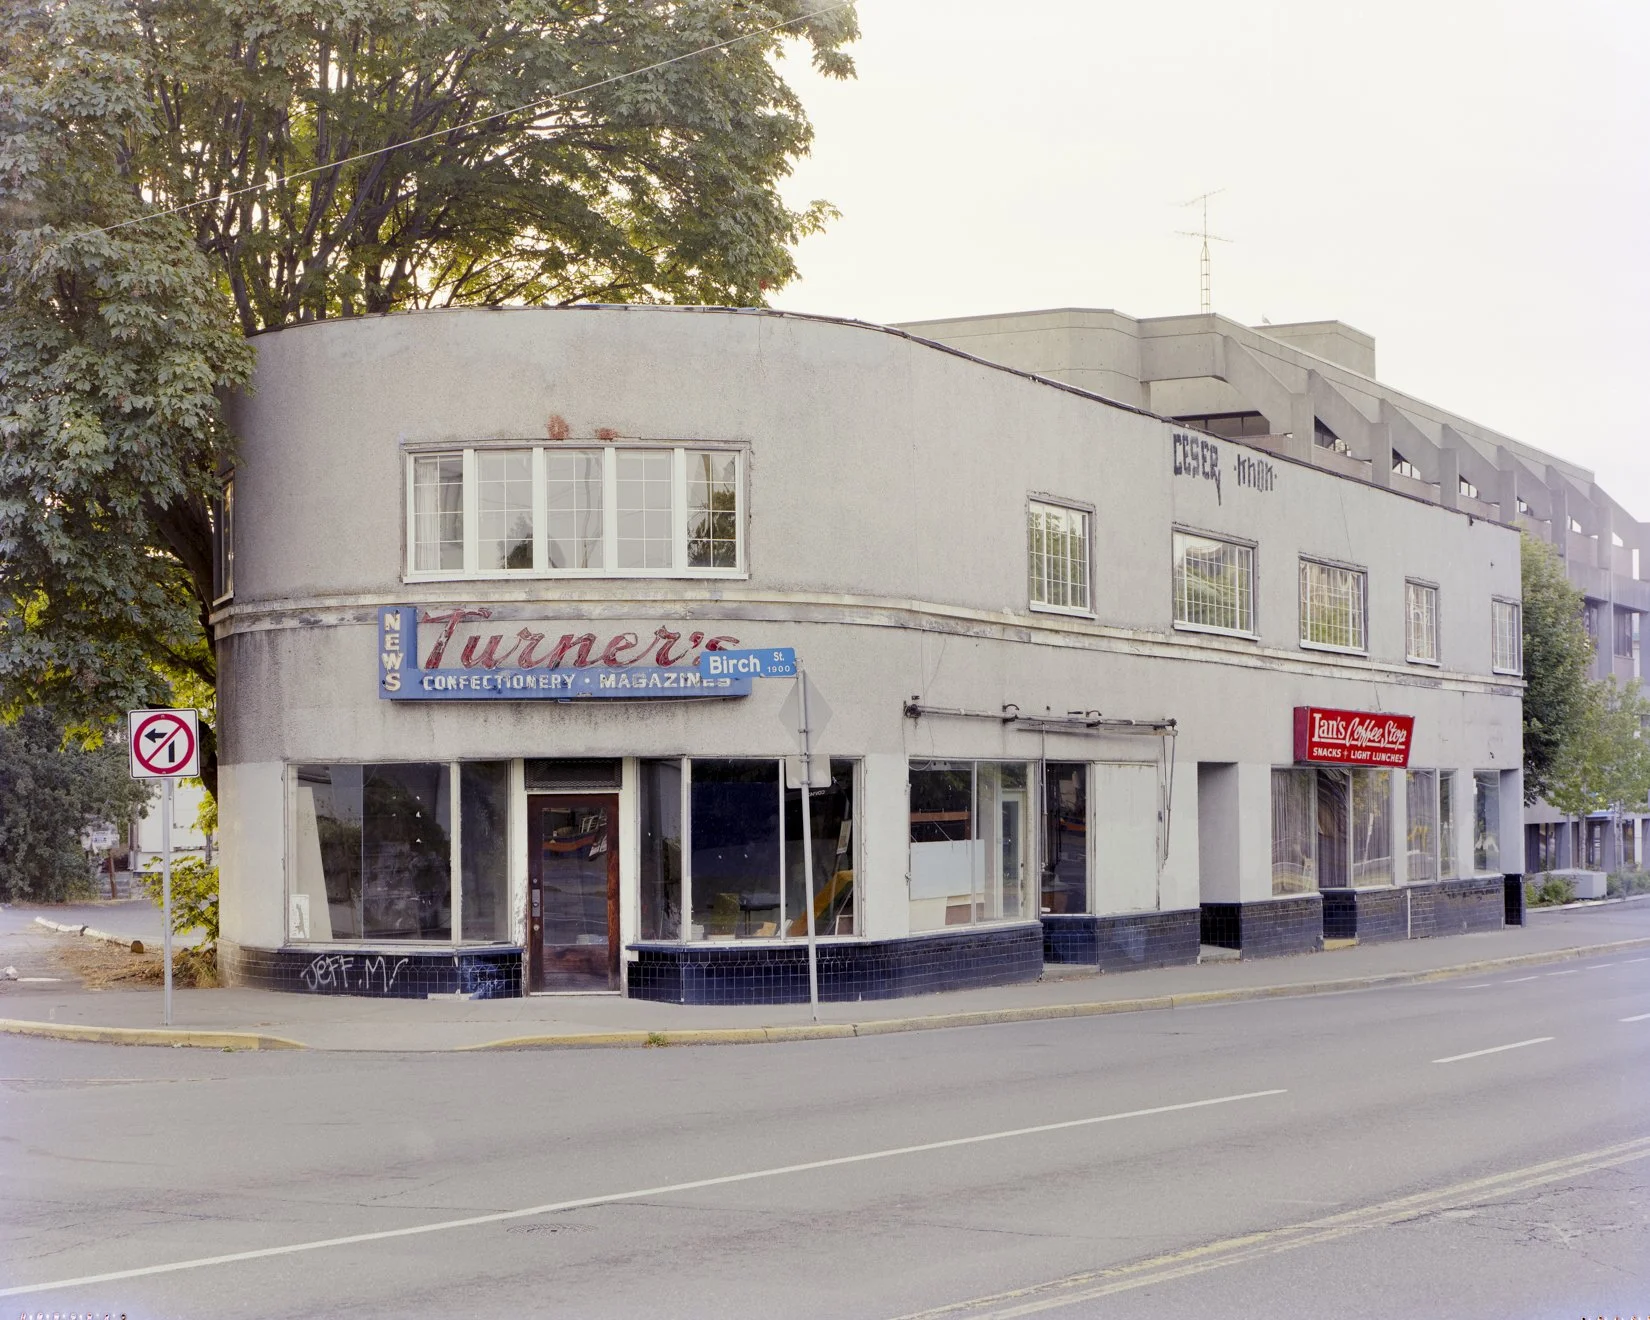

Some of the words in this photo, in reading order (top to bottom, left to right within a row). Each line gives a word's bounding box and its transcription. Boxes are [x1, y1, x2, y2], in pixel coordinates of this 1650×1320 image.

[381, 613, 403, 691] NEWS
[709, 654, 760, 675] Birch
[773, 652, 785, 662] St.
[767, 665, 790, 673] 1900
[423, 672, 576, 691] CONFECTIONERY
[1312, 713, 1346, 742] Ian's
[1345, 717, 1382, 747] Coffee
[1380, 720, 1407, 750] Stop
[1312, 747, 1342, 758] SNACKS
[1350, 750, 1371, 760] LIGHT
[1372, 752, 1404, 763] LUNCHES
